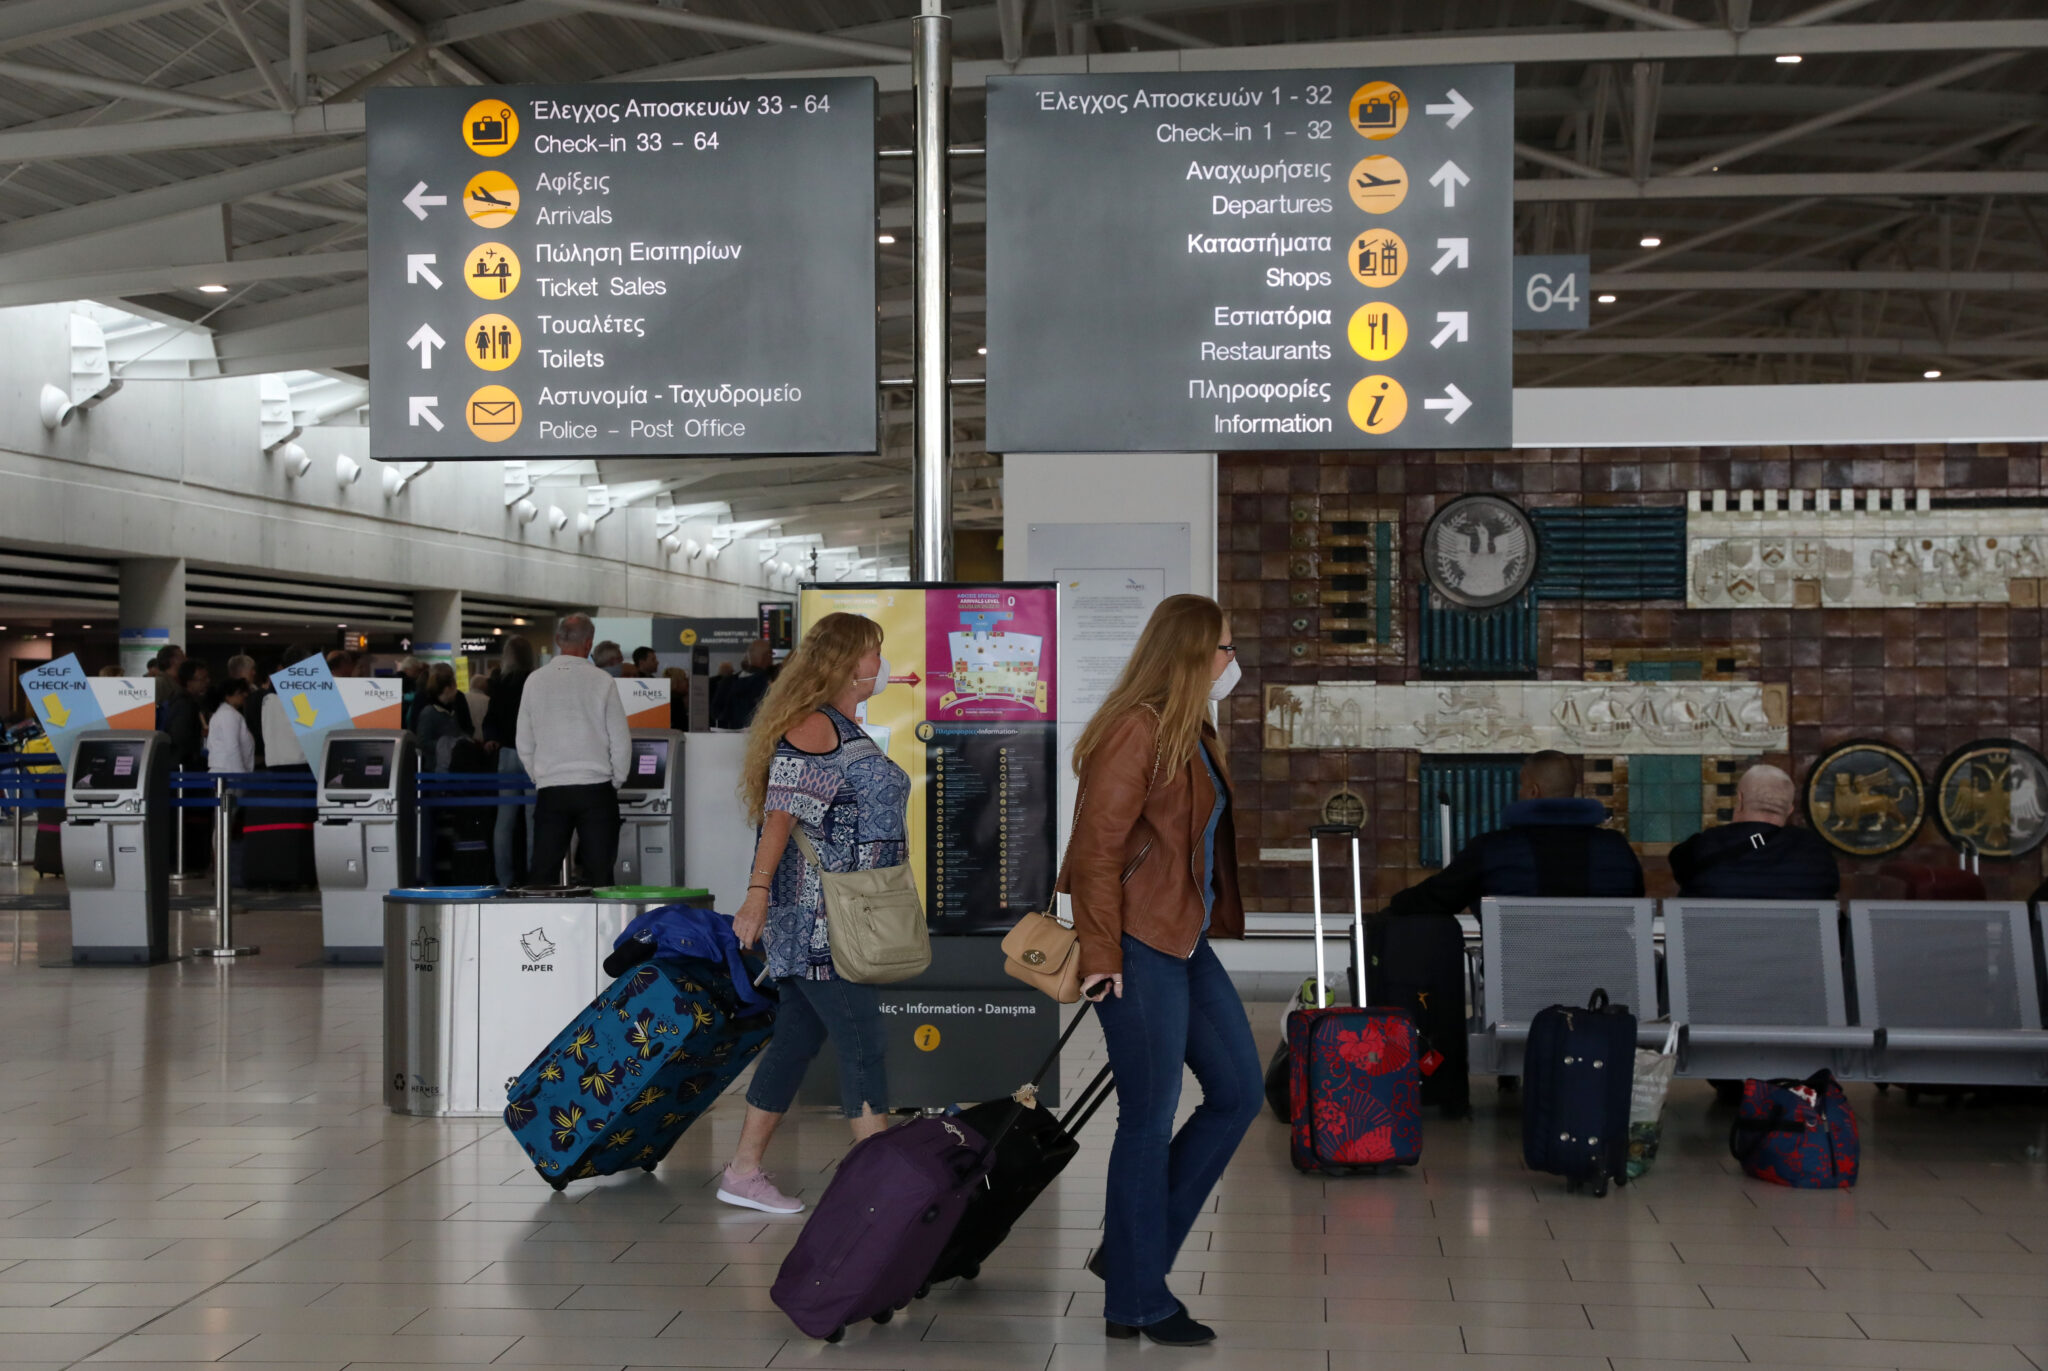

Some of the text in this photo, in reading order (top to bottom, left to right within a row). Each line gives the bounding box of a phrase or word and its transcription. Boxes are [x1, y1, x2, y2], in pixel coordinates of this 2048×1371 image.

[529, 100, 620, 124] Έλεγχος
[624, 96, 751, 118] Αποσκευών
[757, 95, 783, 115] 33
[804, 94, 831, 114] 64
[1035, 91, 1129, 115] Έλεγχος
[1132, 86, 1263, 109] Αποσκευών
[1271, 86, 1280, 106] 1
[1305, 85, 1333, 105] 32
[1156, 123, 1252, 143] Check-in
[1263, 121, 1271, 141] 1
[1307, 119, 1333, 140] 32
[534, 133, 627, 154] Check-in
[636, 132, 663, 152] 33
[693, 131, 720, 151] 64
[1185, 159, 1332, 185] Αναχωρήσεις
[535, 171, 610, 196] Αφίξεις
[535, 205, 613, 226] Arrivals
[1212, 194, 1333, 219] Departures
[536, 240, 742, 267] Πώληση Εισιτηρίων
[1187, 232, 1332, 257] Καταστήματα
[536, 276, 667, 297] Ticket Sales
[1265, 267, 1332, 291] Shops
[1526, 272, 1581, 313] 64
[537, 314, 645, 338] Τουαλέτες
[1214, 304, 1332, 330] Εστιατόρια
[537, 348, 605, 369] Toilets
[1201, 340, 1332, 361] Restaurants
[538, 385, 648, 409] Αστυνομία
[668, 383, 802, 408] Ταχυδρομείο
[1189, 378, 1332, 404] Πληροφορίες
[539, 420, 598, 440] Police
[630, 419, 674, 438] Post
[684, 418, 746, 438] Office
[1214, 413, 1333, 434] Information
[1007, 596, 1016, 607] 0
[37, 667, 72, 677] SELF
[287, 667, 320, 677] SELF
[28, 680, 87, 691] CHECK-IN
[118, 689, 149, 699] HERMES
[279, 680, 334, 691] CHECK-IN
[364, 689, 395, 699] HERMES
[632, 689, 663, 699] HERMES
[414, 963, 433, 972] PMD
[521, 964, 554, 972] PAPER
[906, 1002, 976, 1014] Information
[985, 1003, 1036, 1017] Danışma
[411, 1085, 440, 1096] HERMES
